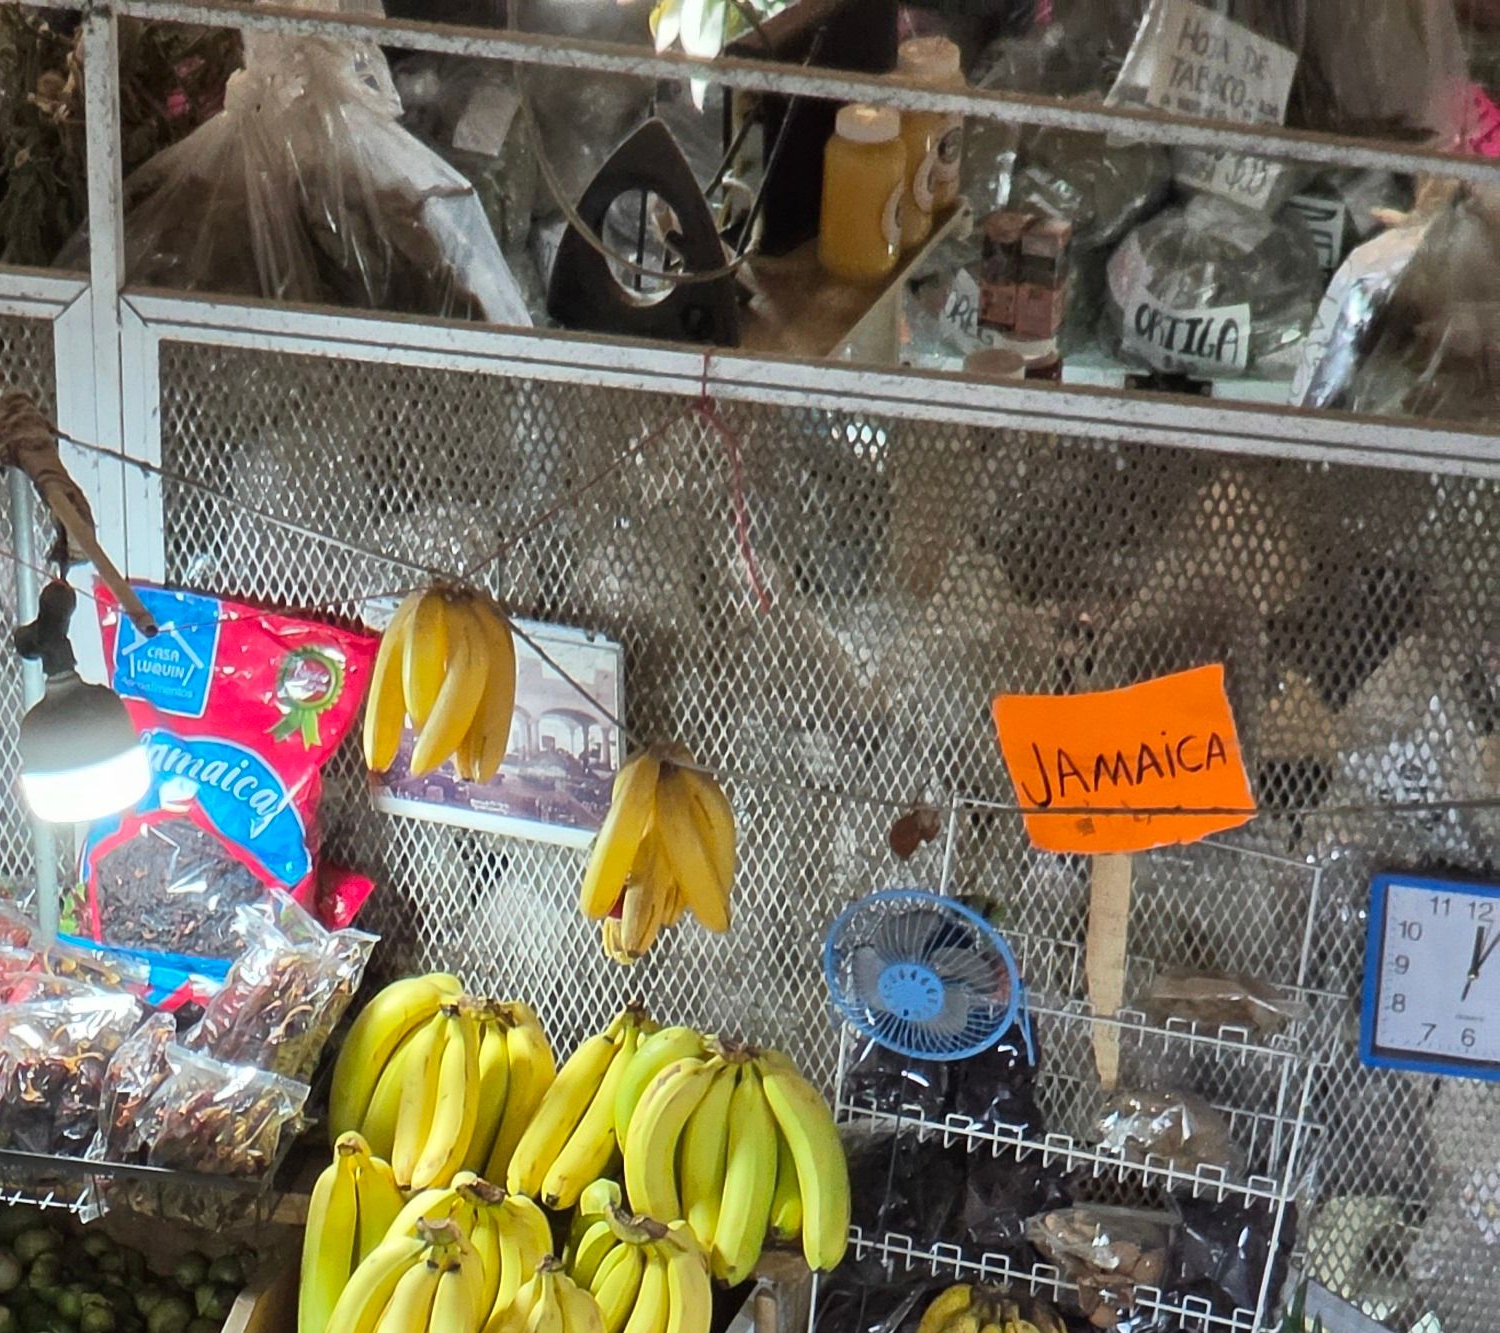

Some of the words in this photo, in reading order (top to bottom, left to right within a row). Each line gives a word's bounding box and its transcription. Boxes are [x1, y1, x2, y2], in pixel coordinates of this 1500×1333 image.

[146, 647, 181, 663] CASA
[1020, 731, 1228, 808] JAMAICA
[1430, 895, 1451, 917] 11
[1469, 900, 1494, 921] 12
[1399, 919, 1423, 942] 10
[1394, 954, 1410, 975] 9
[1391, 992, 1406, 1014] 8
[1421, 1022, 1437, 1042] 7
[1461, 1027, 1476, 1048] 6
